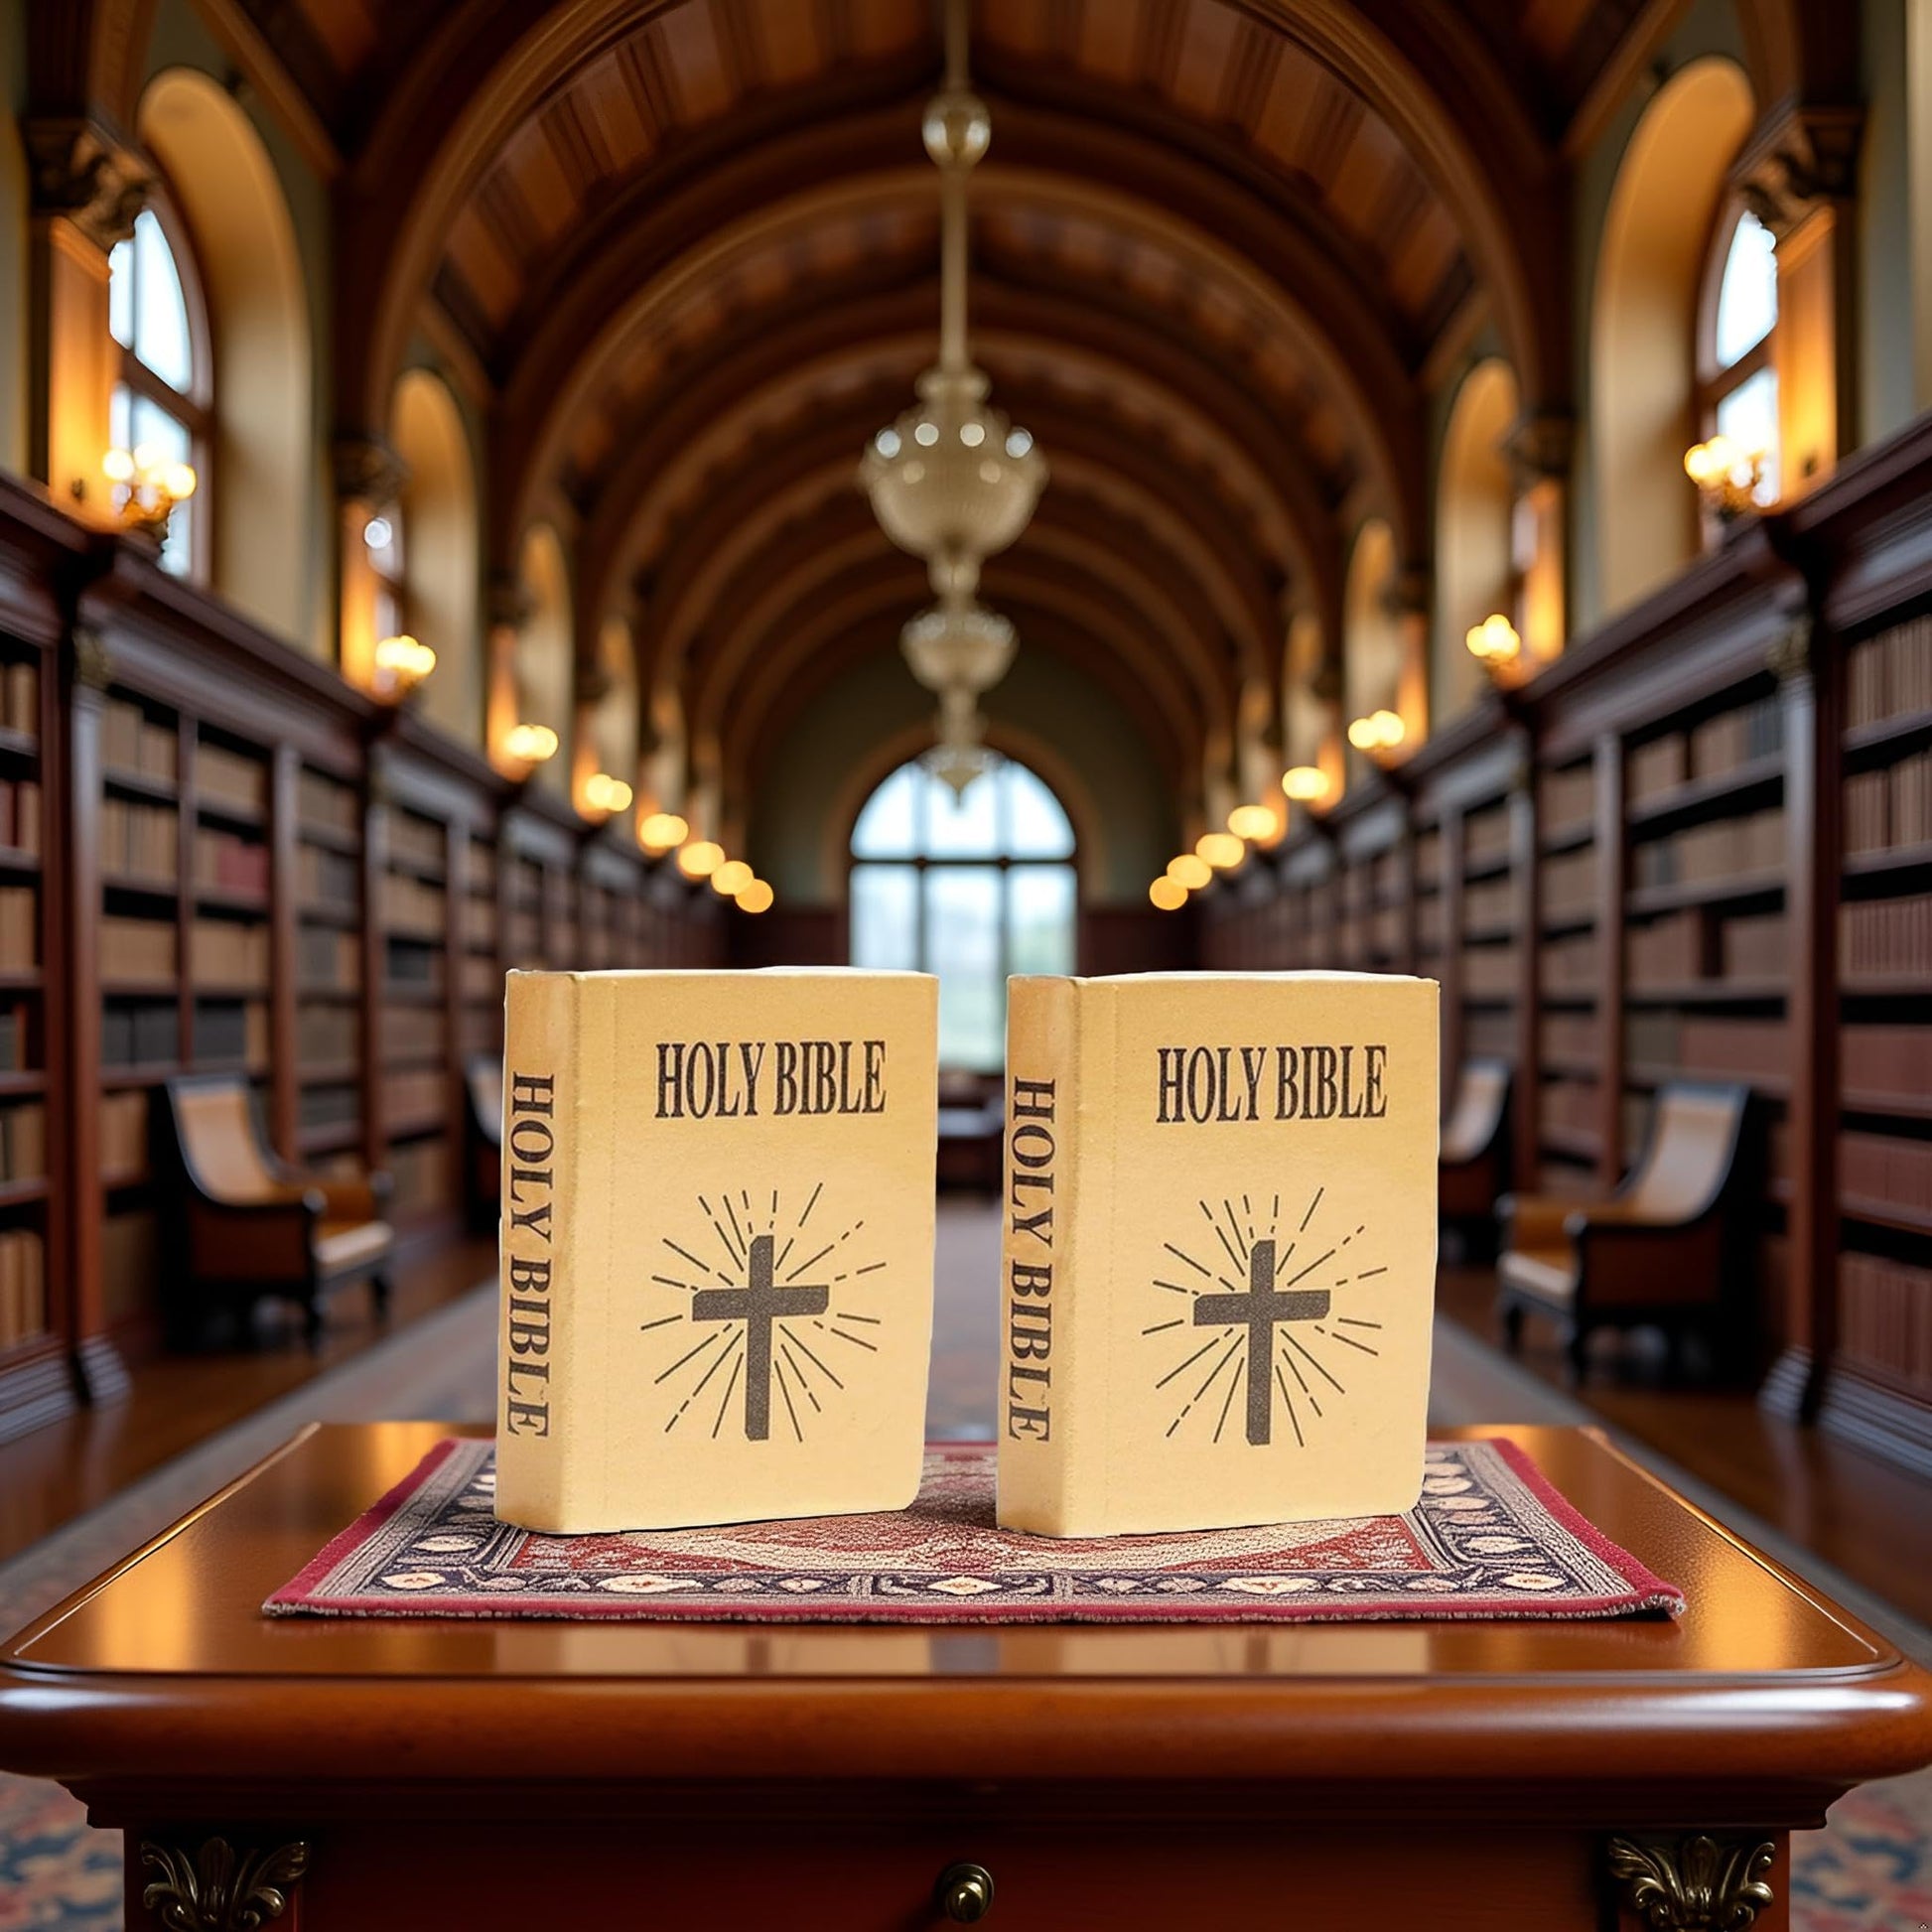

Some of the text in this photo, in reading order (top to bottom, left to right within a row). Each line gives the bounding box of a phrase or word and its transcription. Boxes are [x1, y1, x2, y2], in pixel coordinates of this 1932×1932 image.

[654, 1039, 887, 1120] HOLY BIBLE
[1156, 1044, 1387, 1124] HOLY BIBLE
[507, 1071, 555, 1438] HOLY BIBLE
[1008, 1076, 1056, 1444] HOLY BIBLE
